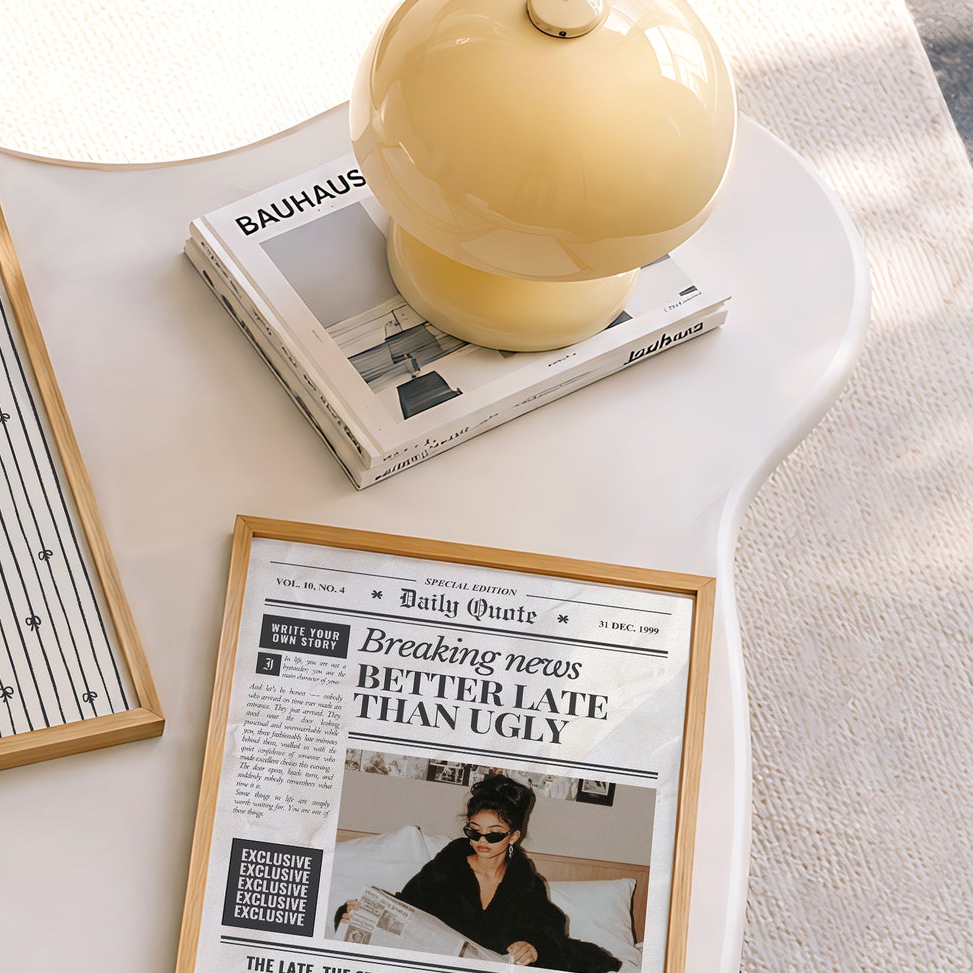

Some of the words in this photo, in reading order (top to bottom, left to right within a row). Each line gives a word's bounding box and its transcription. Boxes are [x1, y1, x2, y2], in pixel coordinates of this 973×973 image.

[235, 169, 367, 236] BAUHAUS
[276, 578, 300, 589] VOL.
[303, 582, 316, 591] 10,
[318, 584, 337, 593] NO.
[338, 586, 345, 594] 4
[425, 578, 468, 590] SPECIAL
[472, 585, 517, 595] EDITION
[400, 588, 459, 618] Daily
[467, 599, 537, 624] Quote
[271, 623, 306, 637] WRITE
[309, 628, 340, 641] YOUR
[598, 620, 608, 629] 31
[611, 622, 636, 633] DEC.
[639, 625, 660, 635] 1999
[272, 635, 297, 645] OWN
[300, 638, 337, 651] STORY
[358, 628, 501, 676] Breaking
[506, 654, 582, 679] news
[248, 683, 263, 691] And
[279, 686, 287, 694] be
[356, 664, 503, 706] BETTER
[514, 684, 608, 720] LATE
[274, 703, 287, 714] They
[327, 710, 341, 721] They
[300, 715, 314, 724] door
[354, 693, 459, 730] THAN
[470, 708, 569, 744] UGLY
[239, 761, 251, 770] The
[251, 763, 266, 772] door
[234, 788, 251, 797] Some
[287, 804, 300, 813] You
[242, 849, 312, 869] EXCLUSIVE
[240, 863, 310, 883] EXCLUSIVE
[238, 877, 308, 897] EXCLUSIVE
[236, 891, 306, 912] EXCLUSIVE
[234, 905, 305, 926] EXCLUSIVE
[246, 956, 274, 973] THE
